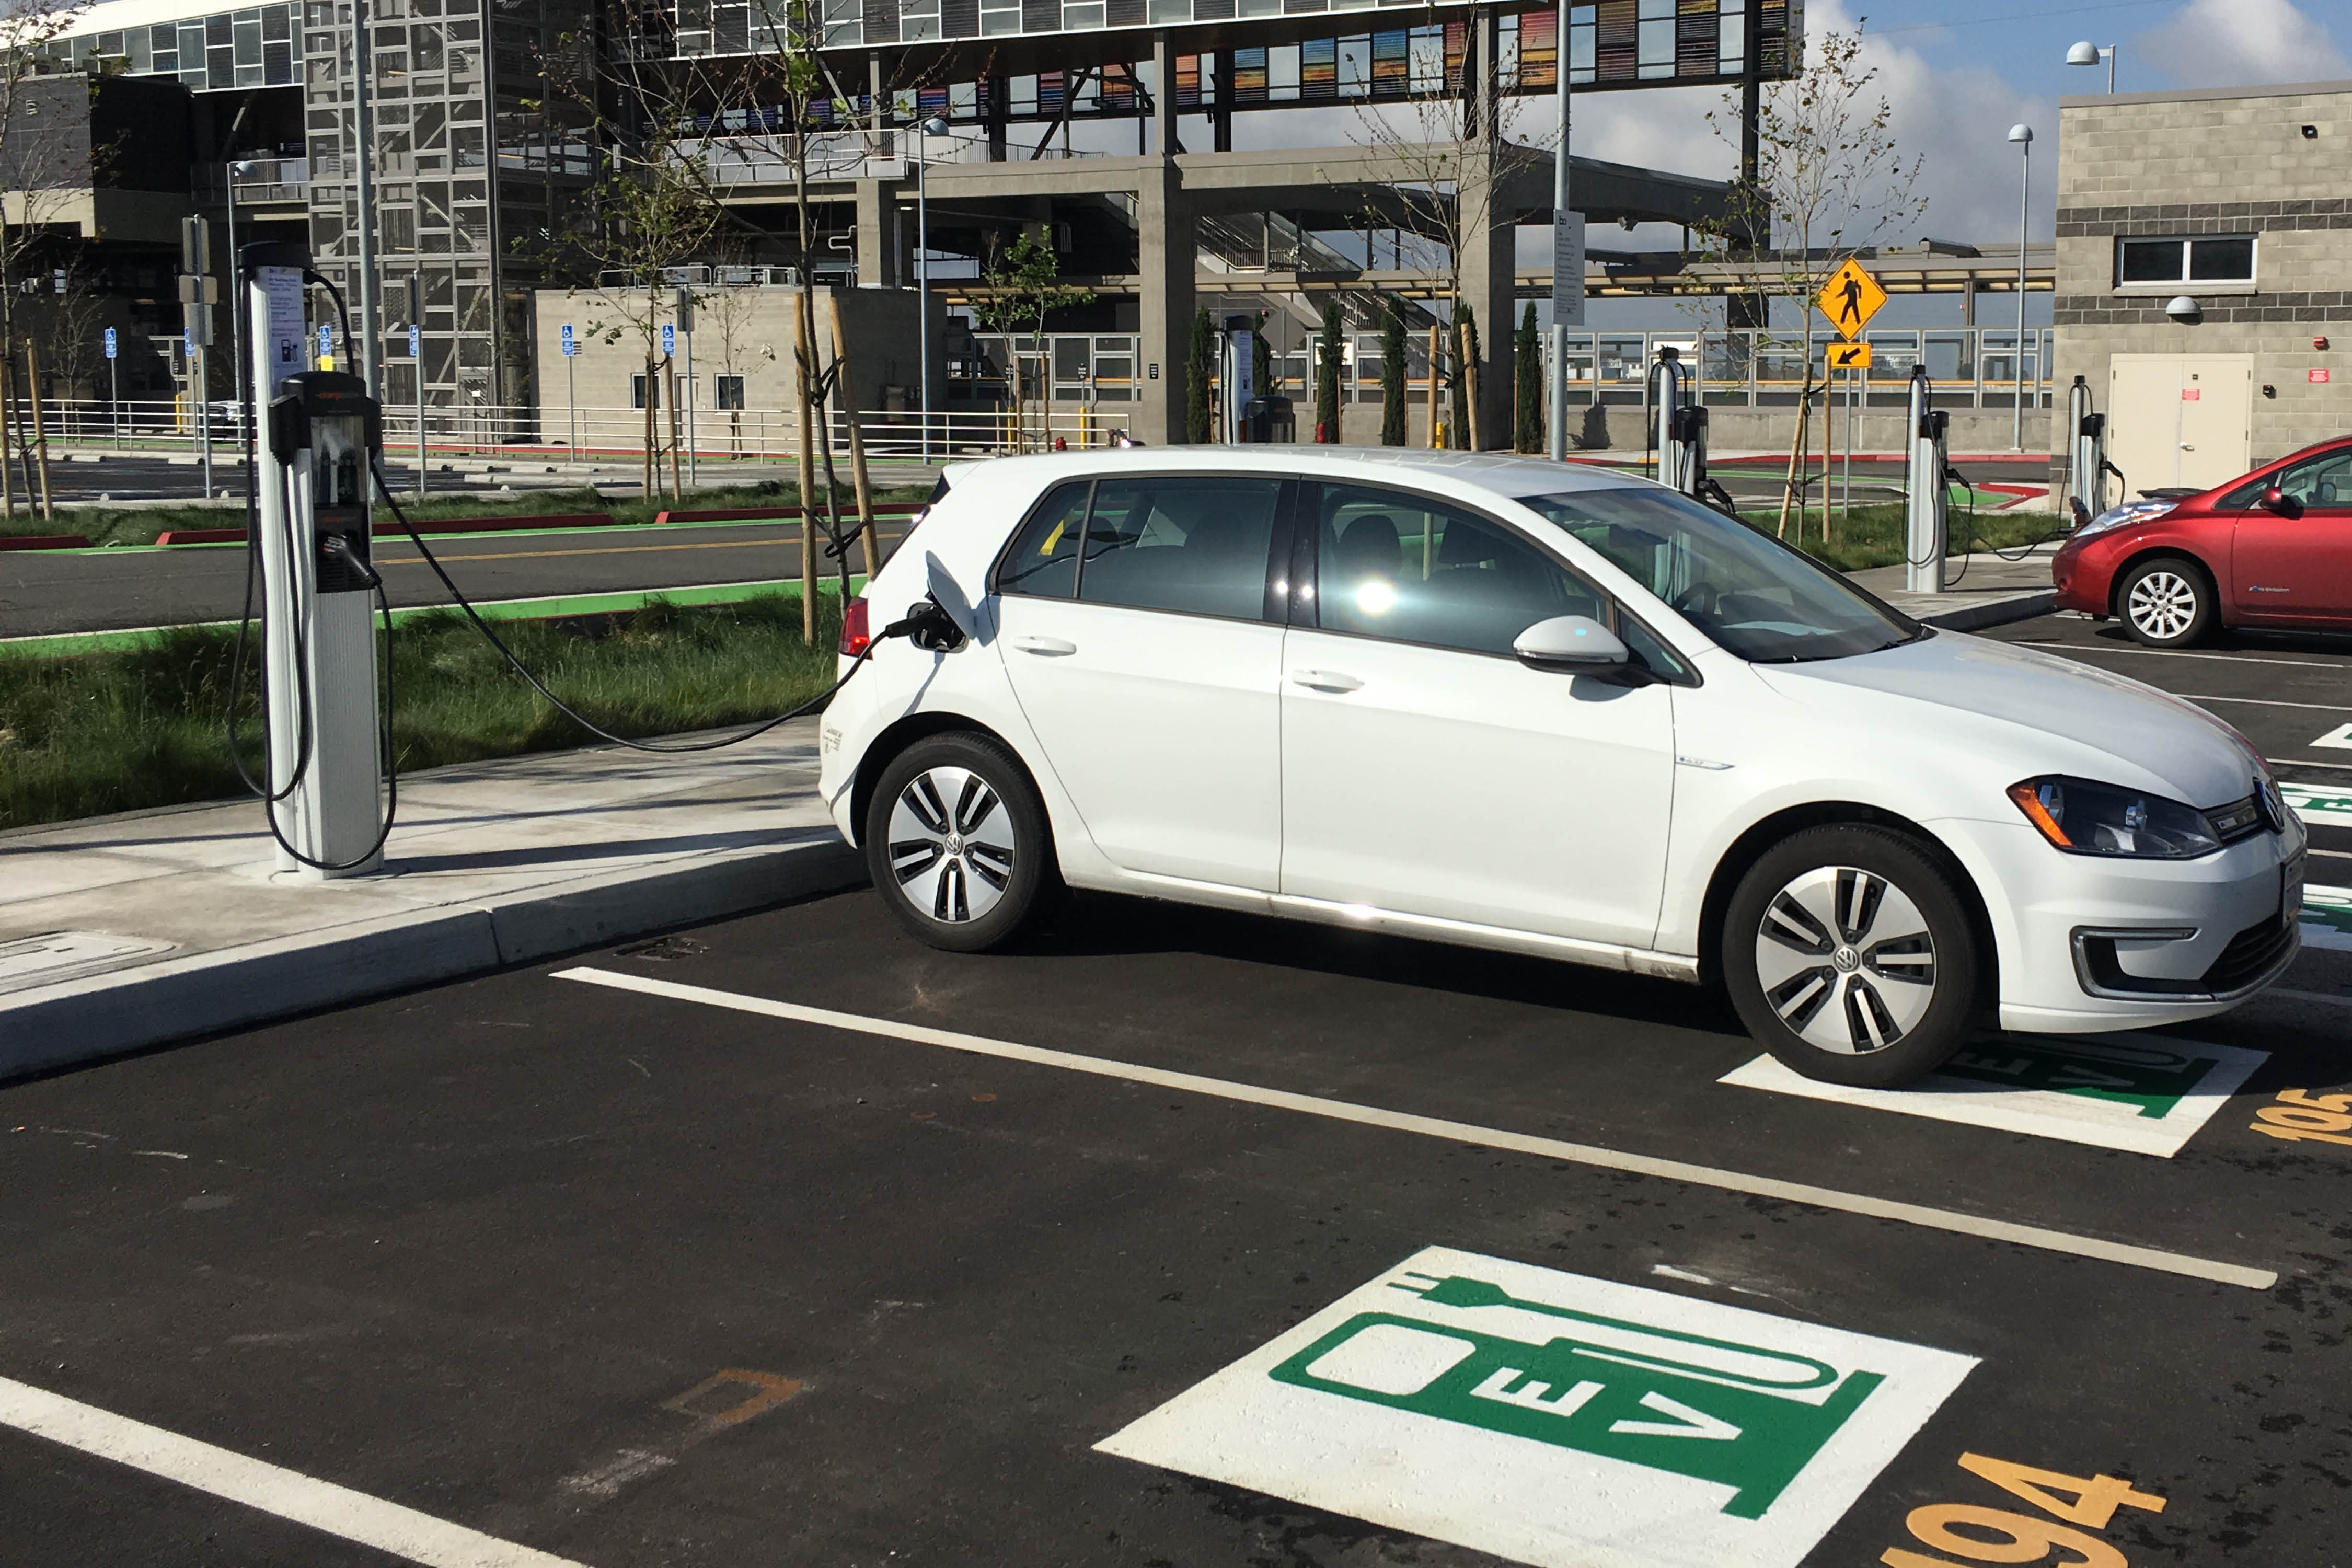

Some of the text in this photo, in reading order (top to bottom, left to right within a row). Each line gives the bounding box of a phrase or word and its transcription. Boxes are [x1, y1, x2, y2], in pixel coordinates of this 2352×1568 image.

[1949, 1052, 2135, 1087] EV
[2249, 1088, 2352, 1146] 105
[1469, 1366, 1743, 1440] EV
